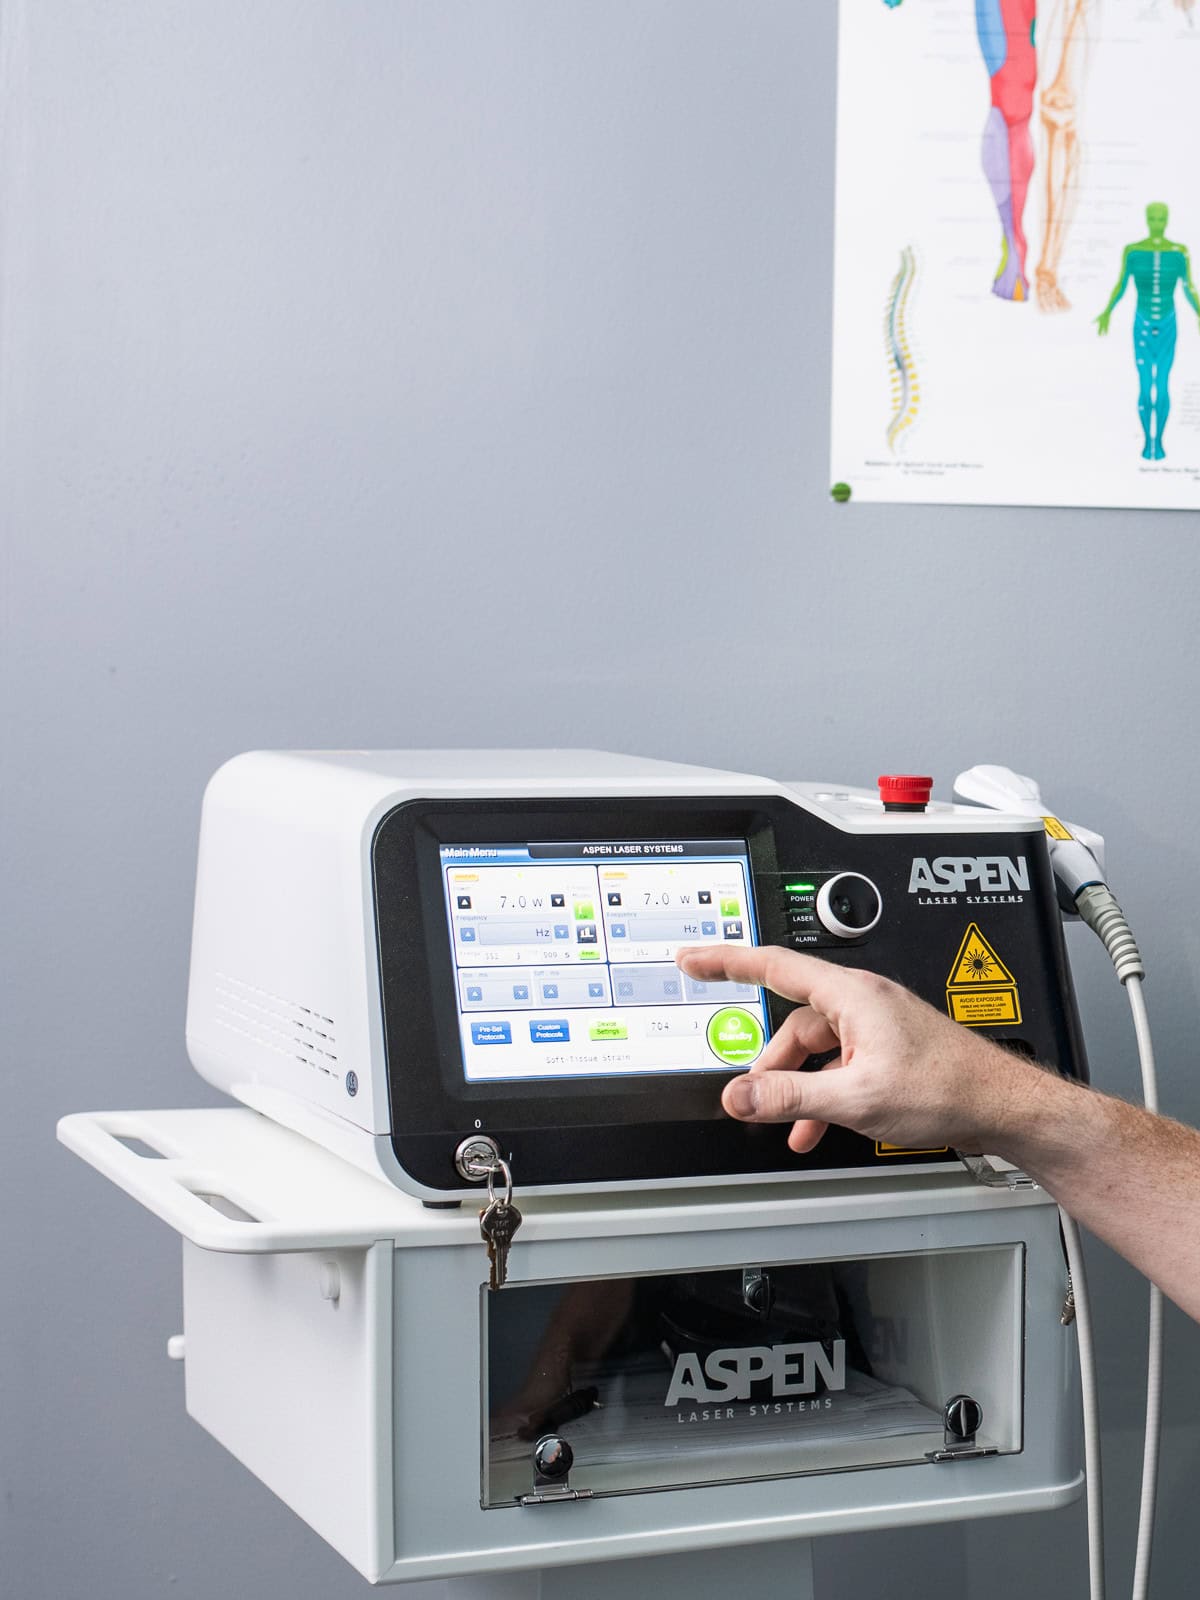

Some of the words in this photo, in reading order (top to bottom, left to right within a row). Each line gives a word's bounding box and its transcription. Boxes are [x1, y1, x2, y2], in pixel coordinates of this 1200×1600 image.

[469, 847, 497, 857] Menu
[582, 846, 612, 854] ASPEN
[614, 844, 641, 854] LASER
[644, 844, 684, 853] SYSTEMS
[907, 856, 1031, 894] ASPEN
[500, 895, 527, 908] 7.0
[644, 892, 670, 906] 7.0
[918, 897, 958, 905] LASER
[966, 895, 1024, 904] SYSTEMS
[536, 928, 550, 937] Hz
[684, 924, 698, 933] Hz
[596, 1028, 620, 1036] Settings
[719, 1032, 753, 1042] Standby
[664, 1339, 846, 1407] ASPEN
[678, 1408, 735, 1424] LASER
[750, 1398, 832, 1416] SYSTEMS
